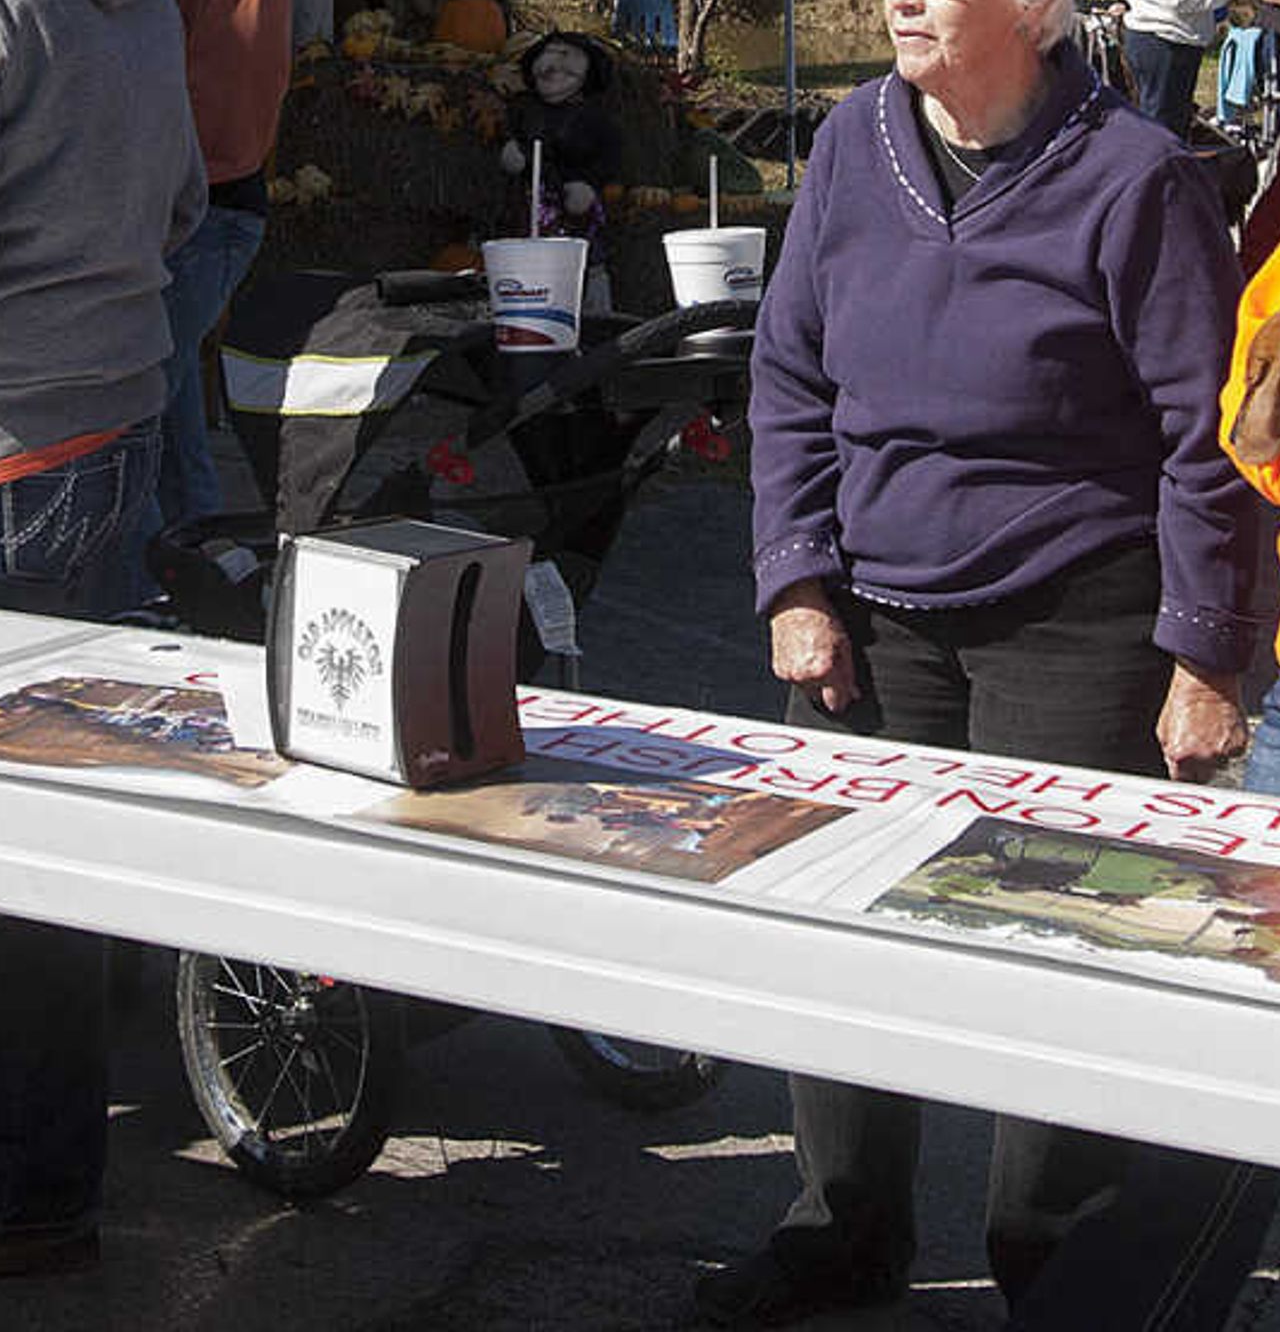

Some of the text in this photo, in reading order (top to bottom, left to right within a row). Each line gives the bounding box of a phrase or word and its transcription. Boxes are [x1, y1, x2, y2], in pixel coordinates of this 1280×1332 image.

[517, 695, 806, 754] OTHE
[537, 731, 912, 805] BRUSH
[832, 753, 1112, 800] HELP
